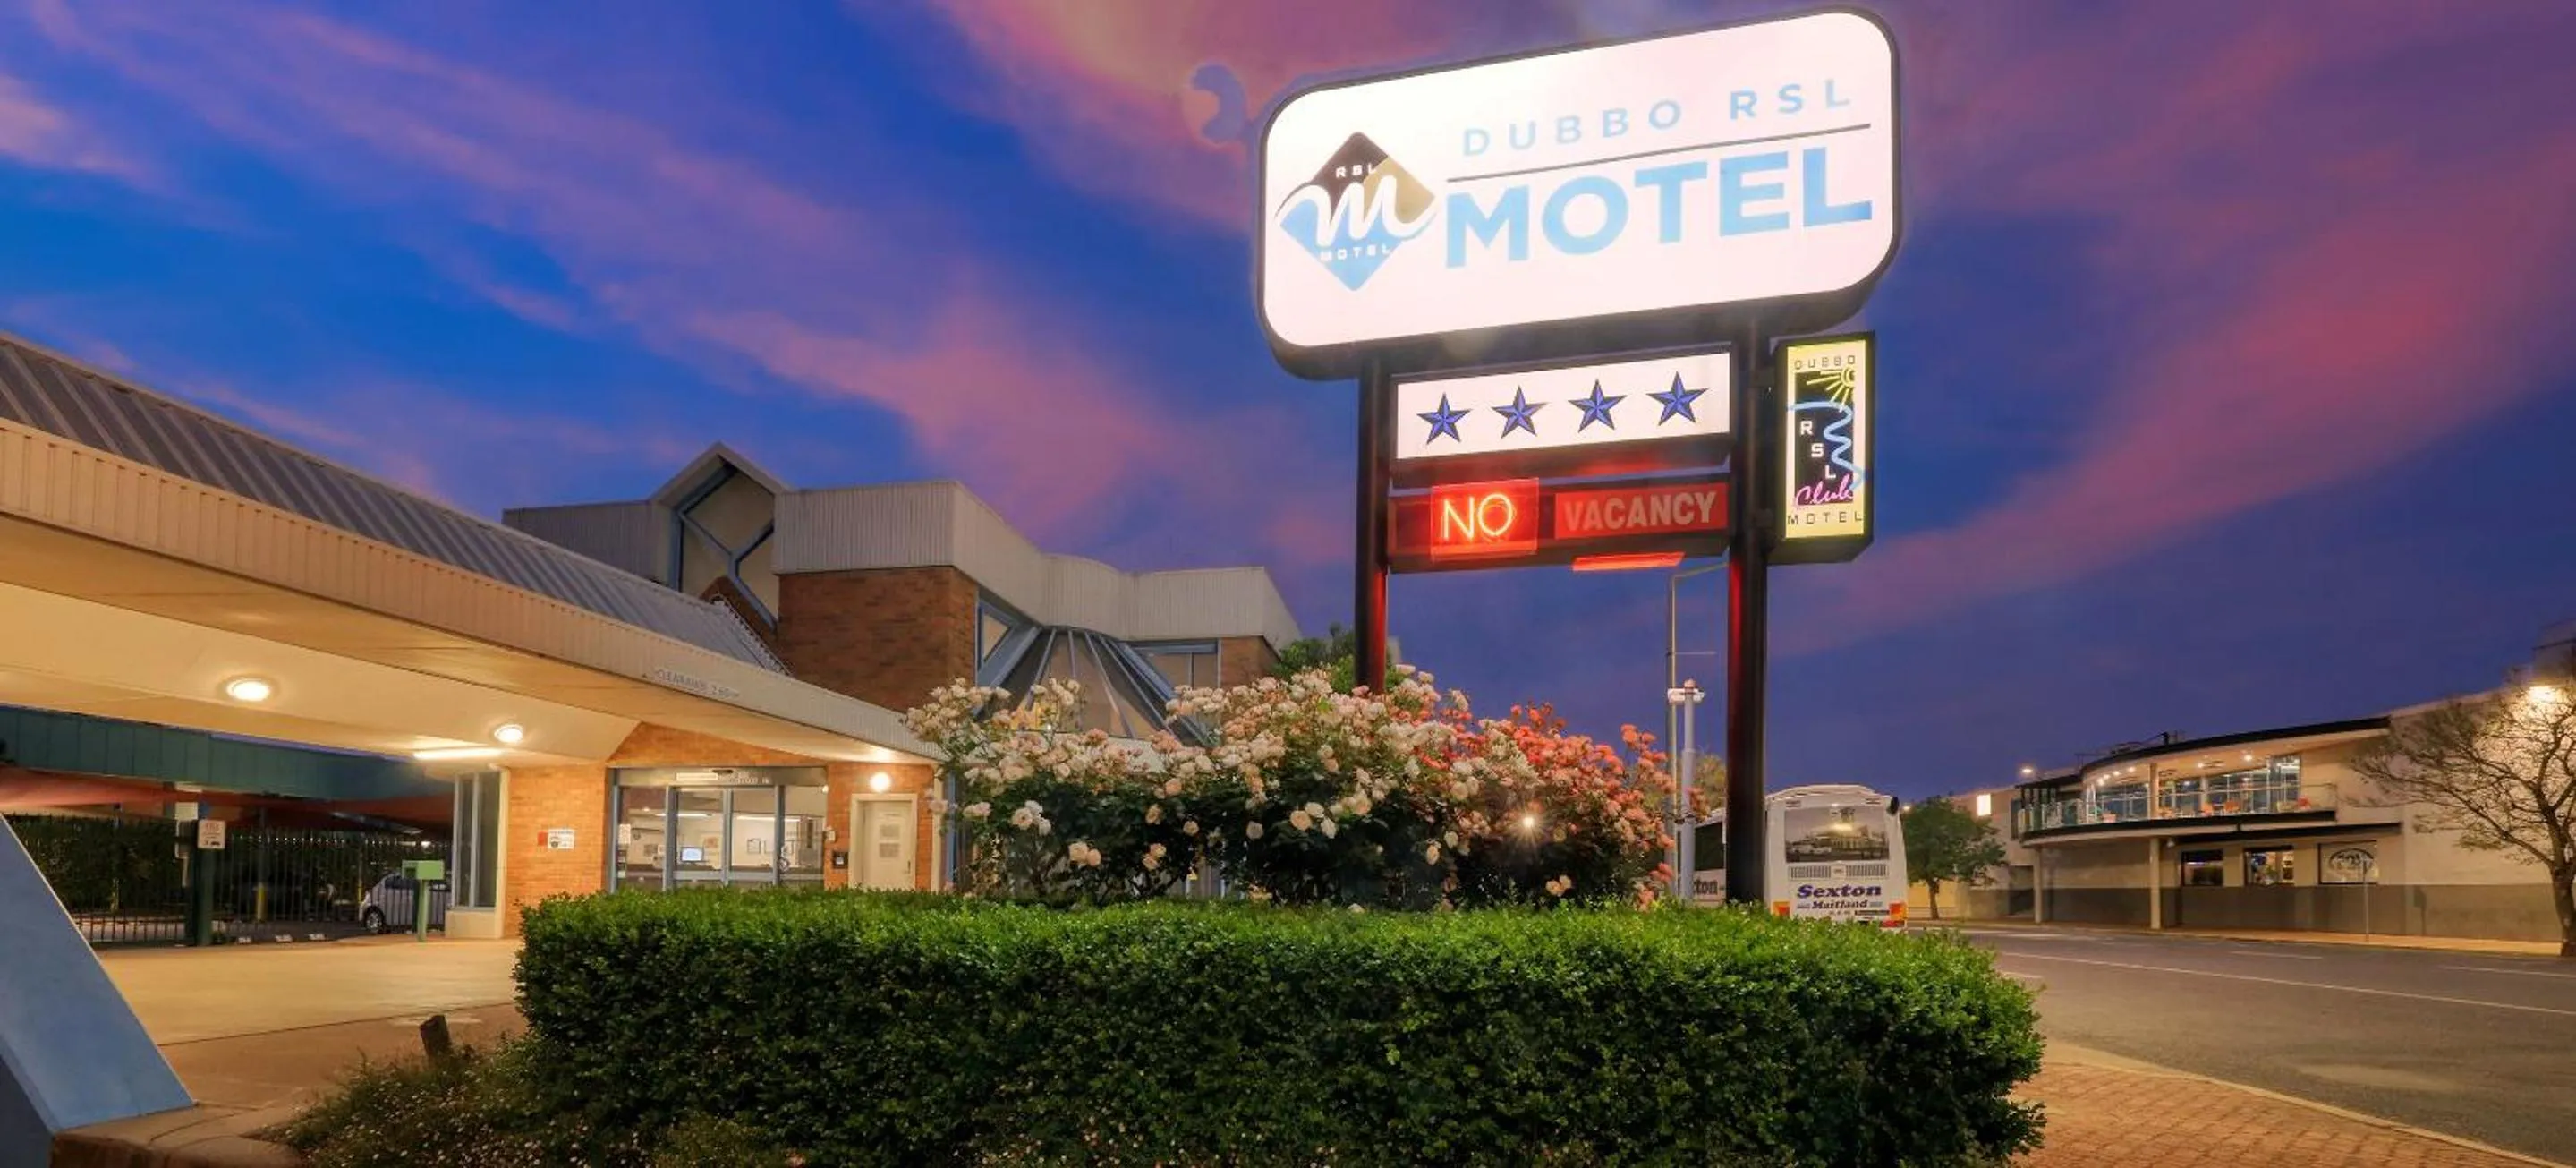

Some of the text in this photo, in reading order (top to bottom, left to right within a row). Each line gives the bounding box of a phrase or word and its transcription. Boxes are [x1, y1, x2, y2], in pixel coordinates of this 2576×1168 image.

[1462, 79, 1850, 158] DUBBO RSL
[1335, 163, 1377, 179] RSL
[1445, 146, 1873, 269] MOTEL
[1320, 243, 1391, 262] MOTEL
[1793, 354, 1857, 371] DUBBO
[1794, 473, 1853, 507] Club
[1442, 490, 1717, 541] NO VACANCY
[1787, 510, 1863, 526] MOTEL
[1797, 883, 1882, 899] Sexton
